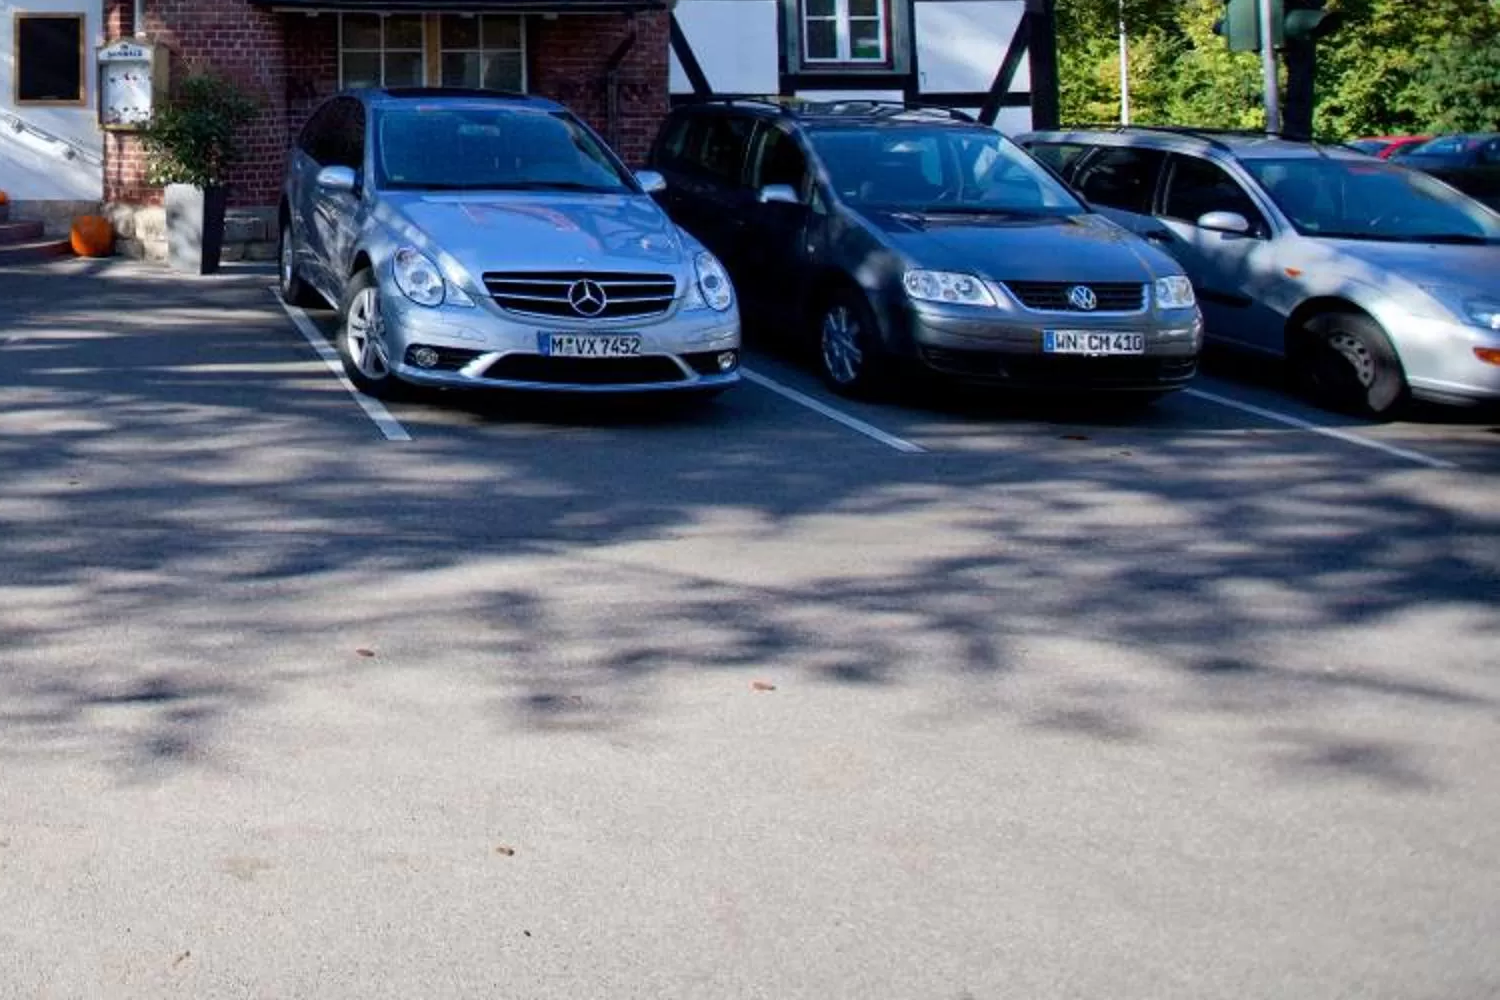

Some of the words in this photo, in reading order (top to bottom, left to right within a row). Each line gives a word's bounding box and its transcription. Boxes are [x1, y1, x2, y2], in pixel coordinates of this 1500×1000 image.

[551, 337, 563, 353] M
[575, 337, 597, 354] VX
[601, 336, 640, 354] 7452
[1056, 333, 1077, 349] WN
